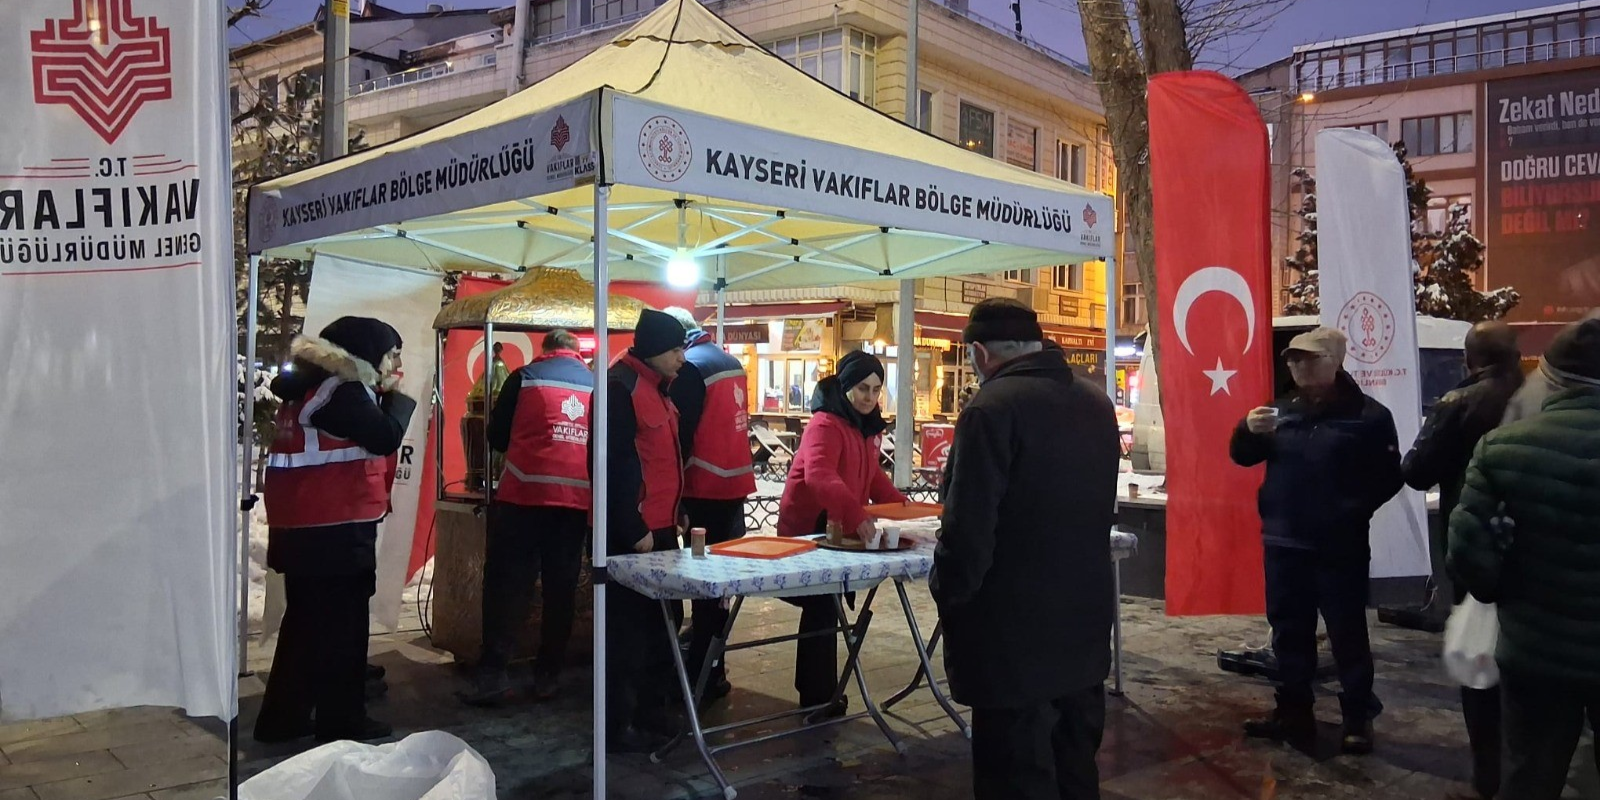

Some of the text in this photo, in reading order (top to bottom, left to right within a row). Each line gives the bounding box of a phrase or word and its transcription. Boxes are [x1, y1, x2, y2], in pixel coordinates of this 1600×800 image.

[1499, 94, 1555, 123] Zekat
[575, 162, 595, 175] KLASS
[1501, 152, 1600, 181] DOĞRU CEV
[282, 137, 534, 227] KAYSERİ VAKIFLAR BÖLGE MÜDÜRLÜĞÜ
[706, 149, 807, 189] KAYSERİ
[812, 168, 910, 207] VAKIFLAR
[915, 184, 972, 218] BÖLGE
[976, 196, 1072, 234] MÜDÜRLÜĞÜ
[552, 425, 589, 437] VAKIFLAR
